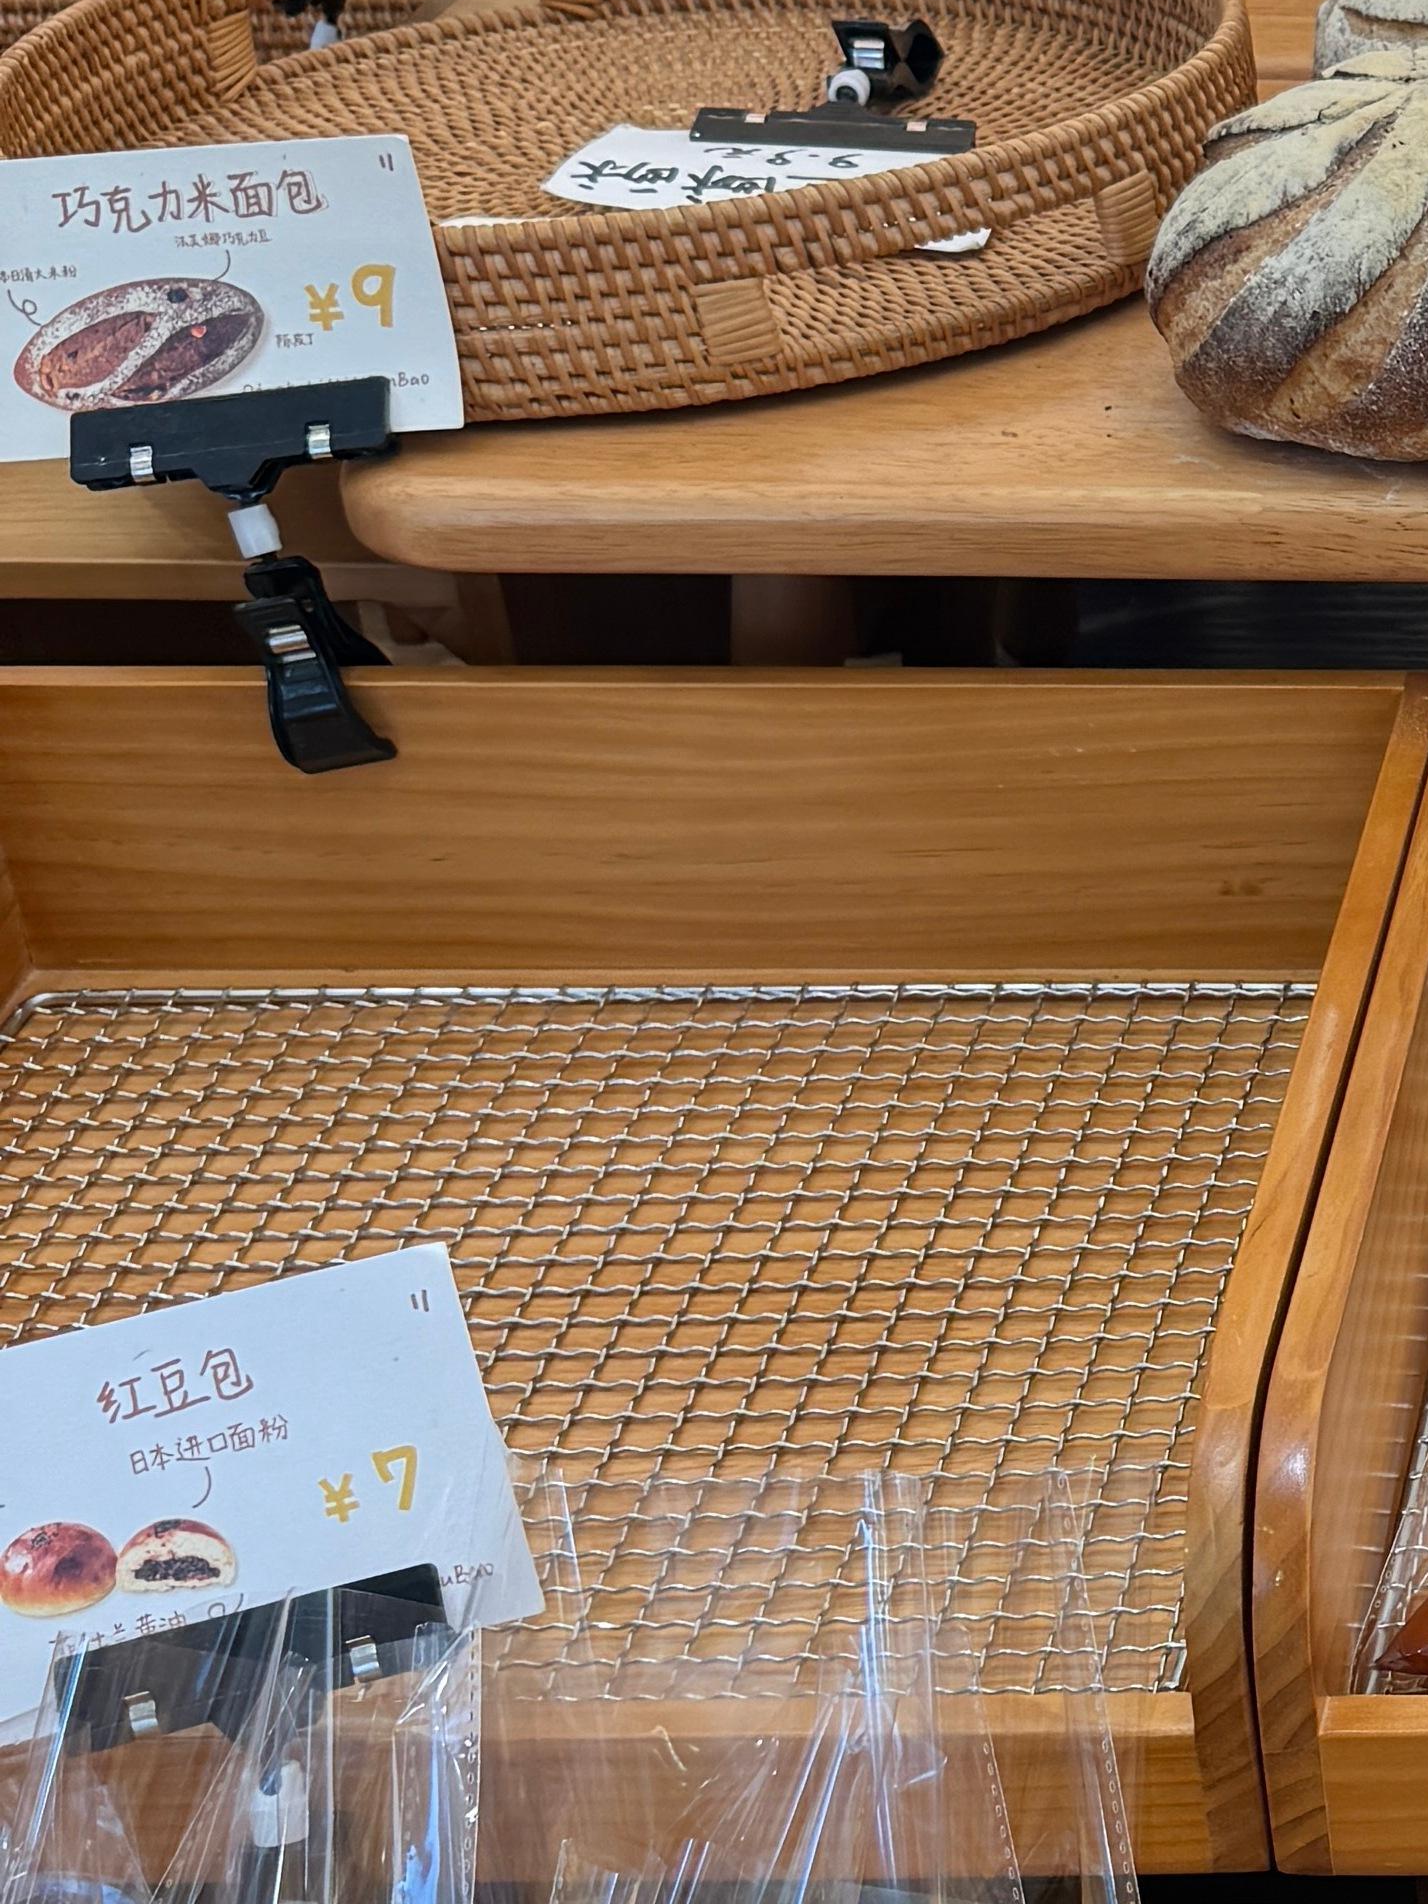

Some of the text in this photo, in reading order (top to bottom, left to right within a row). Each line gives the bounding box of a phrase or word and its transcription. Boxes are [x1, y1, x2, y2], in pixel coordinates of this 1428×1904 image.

[52, 169, 324, 234] 巧克力米面包
[304, 263, 397, 331] ¥9
[96, 1346, 255, 1424] 红豆包
[130, 1413, 290, 1475] 日本进口面粉
[318, 1445, 419, 1523] ¥7
